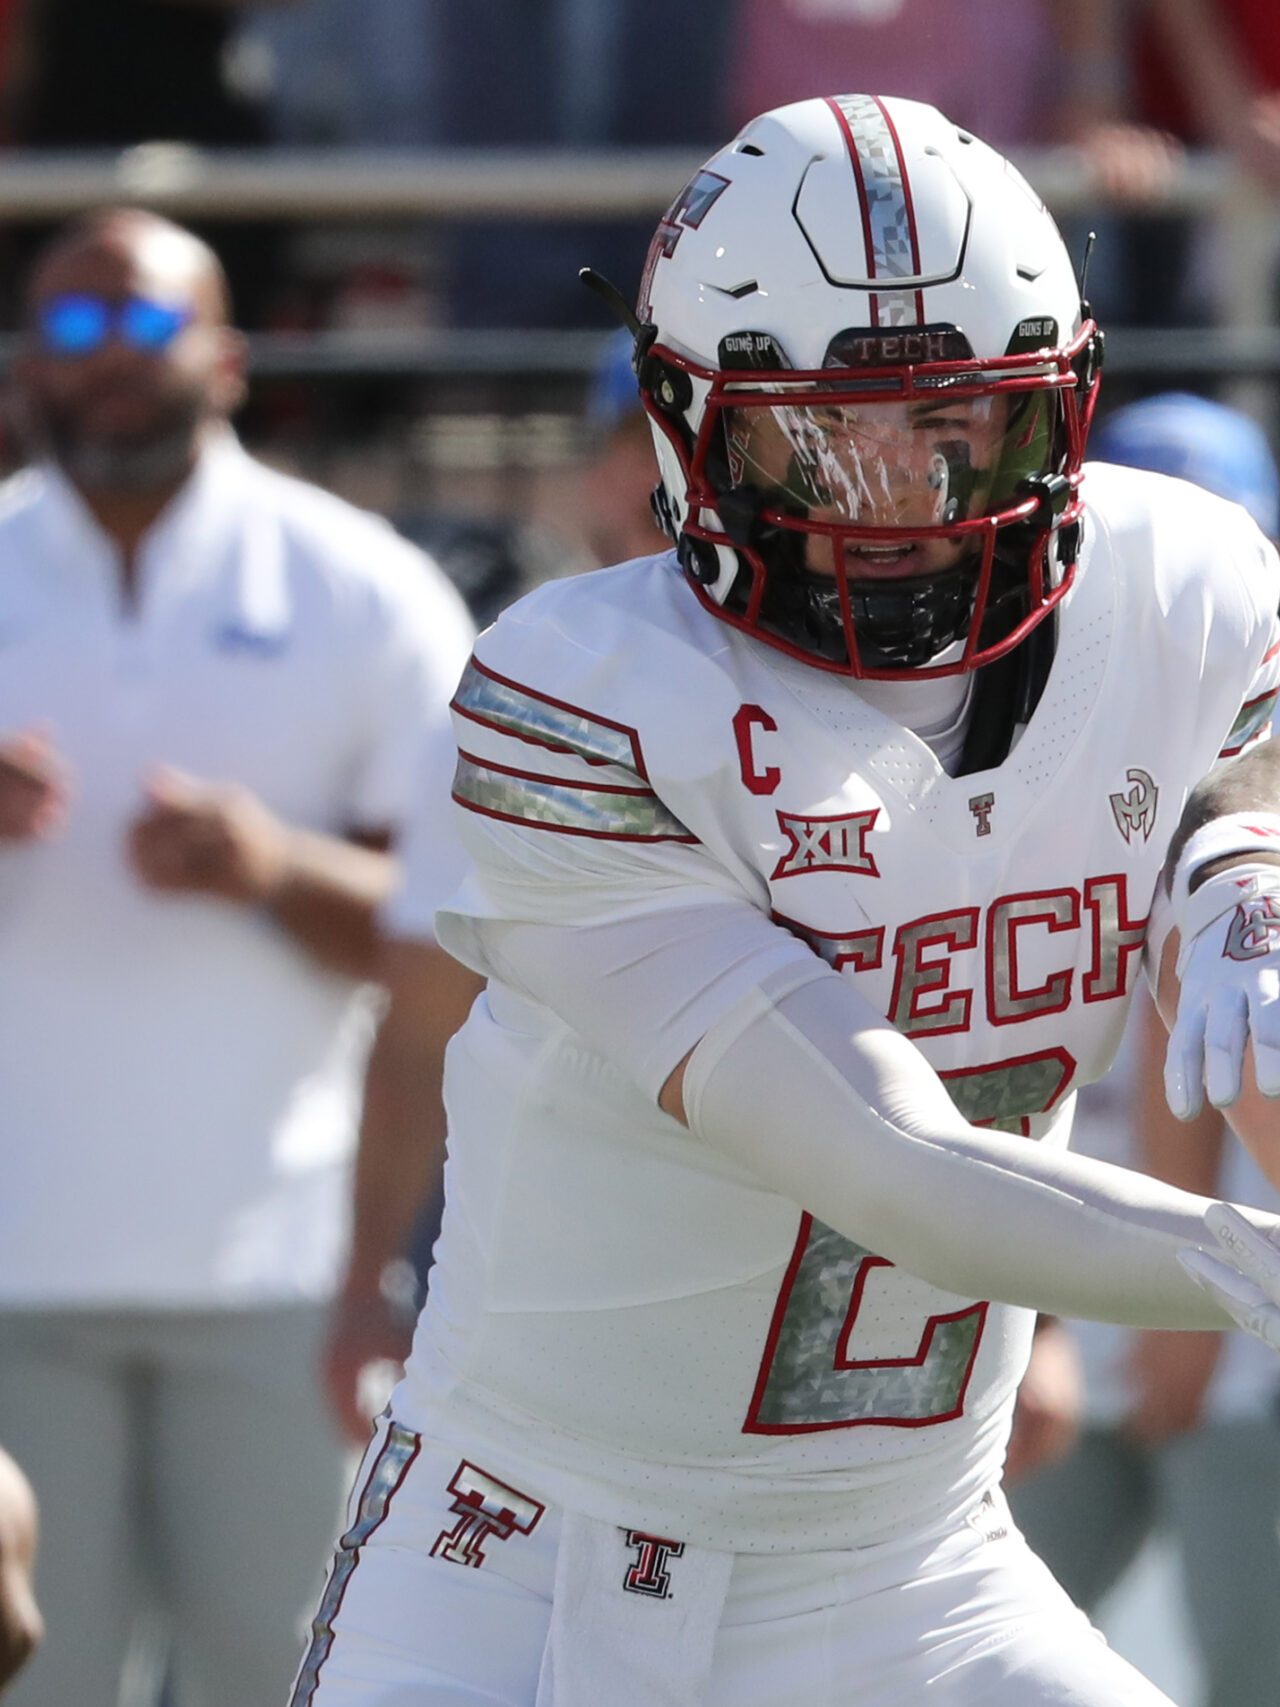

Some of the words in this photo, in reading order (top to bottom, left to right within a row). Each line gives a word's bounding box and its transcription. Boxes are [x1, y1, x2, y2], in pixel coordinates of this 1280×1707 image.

[1018, 321, 1042, 337] GUNS
[1043, 320, 1054, 336] UP
[725, 336, 753, 352] GUNS
[755, 335, 771, 351] UP
[853, 334, 946, 360] TECH
[732, 703, 782, 796] C
